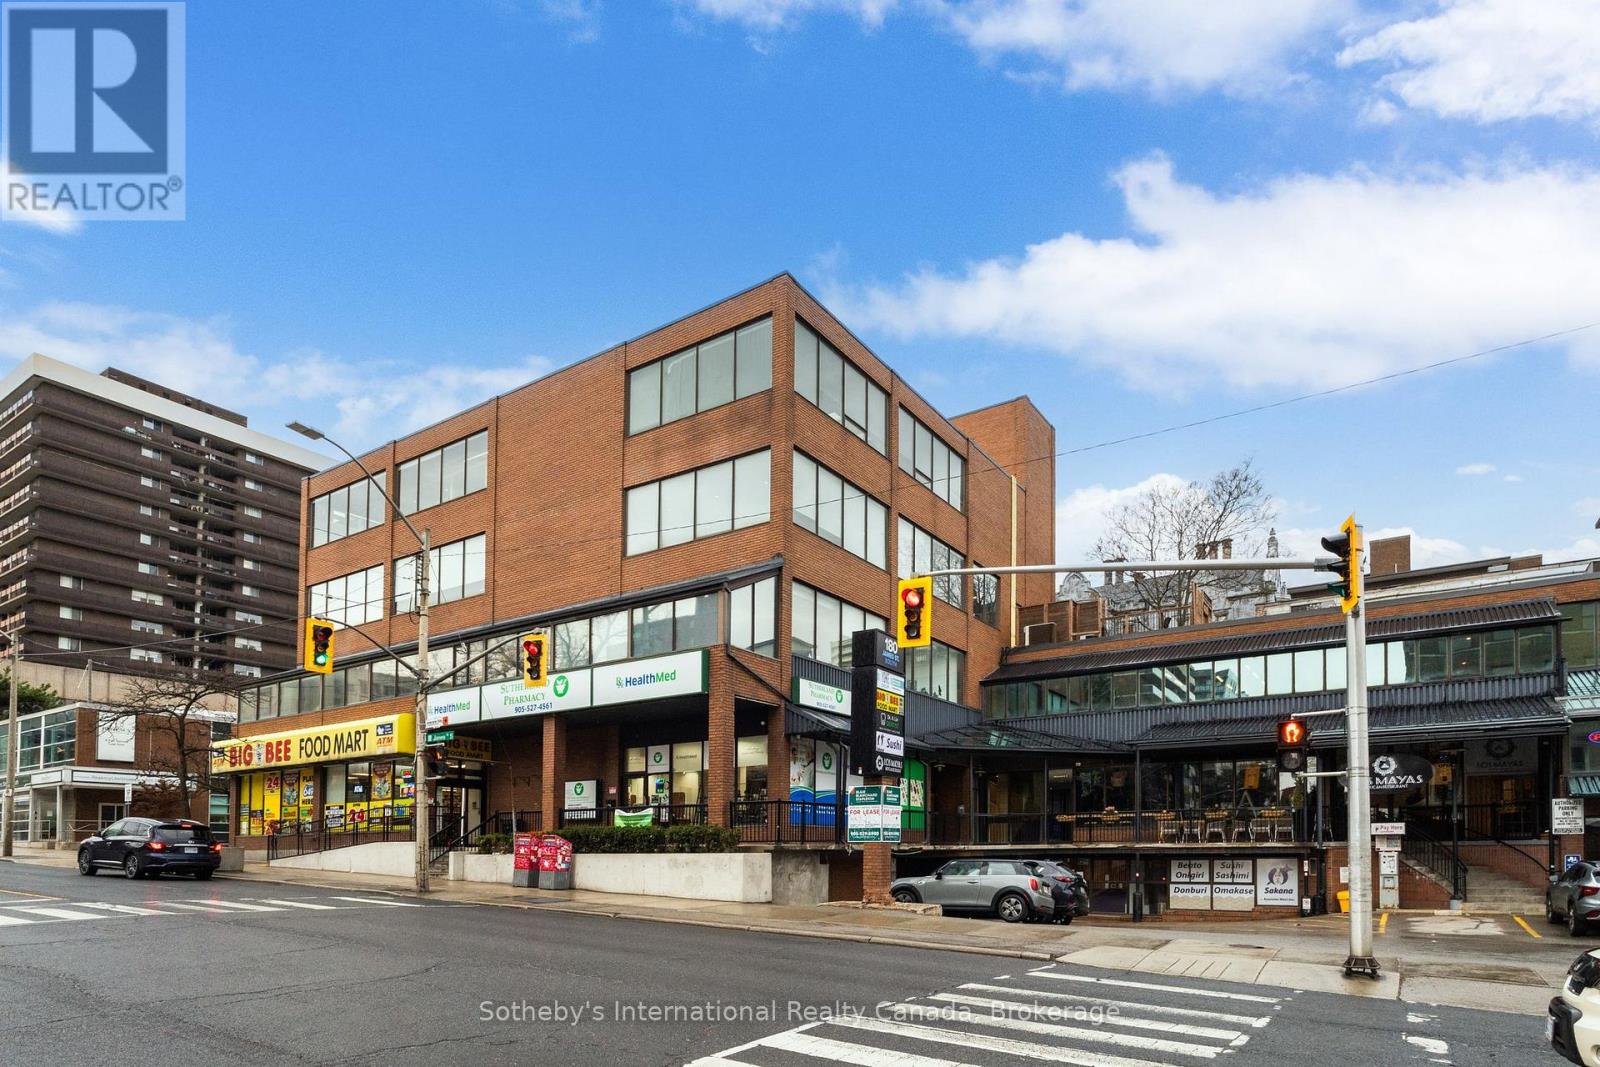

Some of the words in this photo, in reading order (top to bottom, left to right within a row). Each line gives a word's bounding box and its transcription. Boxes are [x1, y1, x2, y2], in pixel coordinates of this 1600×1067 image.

[885, 637, 898, 654] 180
[625, 670, 676, 687] HealthMed
[504, 693, 545, 706] PHARMACY
[434, 701, 471, 714] HealthMed
[514, 702, 553, 714] 905-527-4561
[229, 744, 253, 767] BIG
[265, 739, 292, 763] BEE
[299, 735, 331, 759] FOOD
[334, 729, 369, 755] MART
[886, 739, 902, 751] Sushi
[266, 775, 279, 789] 24
[1375, 774, 1424, 785] MAYAS
[1173, 886, 1207, 895] Donburi
[1214, 886, 1254, 895] Omakase
[1264, 886, 1294, 895] Sakana
